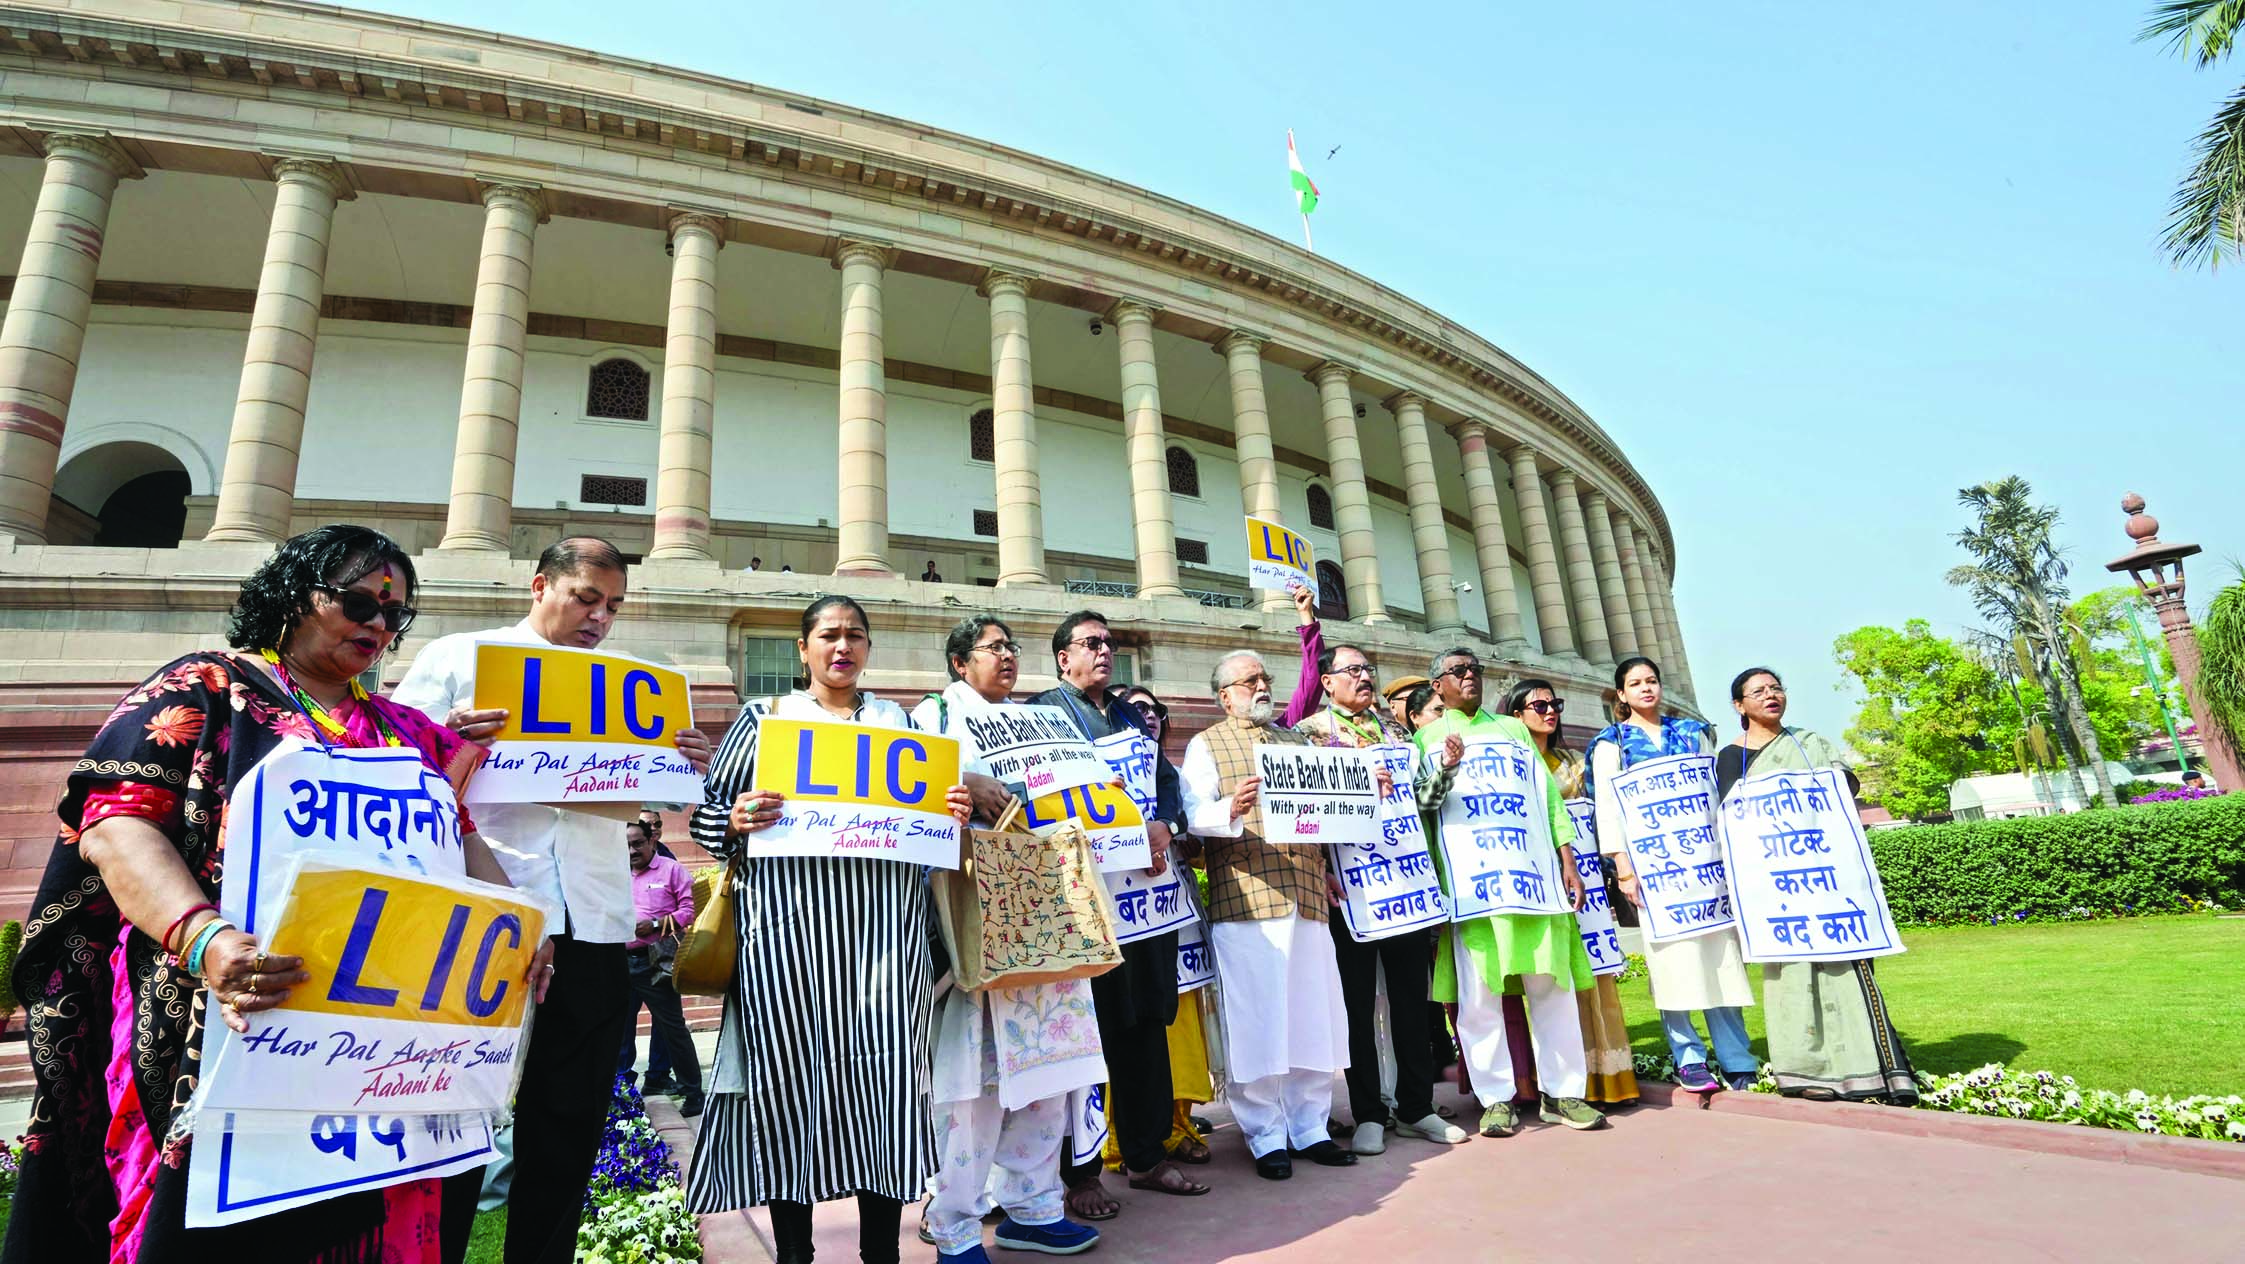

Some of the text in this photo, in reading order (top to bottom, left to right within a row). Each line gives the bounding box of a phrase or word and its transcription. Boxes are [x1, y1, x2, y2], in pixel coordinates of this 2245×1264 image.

[1263, 525, 1308, 572] LIC
[1253, 565, 1270, 576] Har
[1272, 567, 1286, 578] Pal
[521, 657, 664, 740] LIC
[966, 712, 1012, 752] State
[1001, 712, 1044, 743] Bank
[1042, 712, 1080, 741] India
[480, 751, 696, 776] Har Pal Aapke Saath
[796, 729, 928, 804] LIC
[990, 748, 1096, 778] With you all the way
[1026, 768, 1055, 790] Aadani
[1262, 753, 1295, 789] State
[1295, 755, 1327, 789] Bank
[1328, 756, 1341, 790] of
[1341, 756, 1371, 790] India
[563, 773, 639, 799] Aadani ke
[1462, 784, 1528, 819] प्रोटेक्ट
[1734, 777, 1832, 821] आदानी को
[1024, 782, 1115, 829] LIC
[1271, 800, 1375, 819] With you all the way
[1637, 793, 1711, 829] नुकसान
[773, 811, 954, 840] ar Pal Aapke Saath
[832, 832, 898, 852] Aadani ke
[1108, 834, 1145, 850] Saath
[1295, 820, 1320, 834] Aadani
[1382, 814, 1419, 846] हुआ
[1472, 827, 1528, 852] करना
[1672, 825, 1715, 854] हुआ
[1759, 821, 1831, 858] प्रोटेक्ट
[1345, 853, 1392, 888] मोदी
[1471, 860, 1546, 904] बंद करो
[1769, 866, 1838, 895] करना
[1115, 877, 1149, 926] बंद
[1369, 889, 1427, 921] जवाब
[1665, 896, 1718, 925] जवाब
[1767, 897, 1869, 950] बंद करो
[327, 887, 522, 1018] LIC
[242, 1026, 514, 1073] Har Pal Aapke Saath
[354, 1069, 451, 1106] Aadani ke
